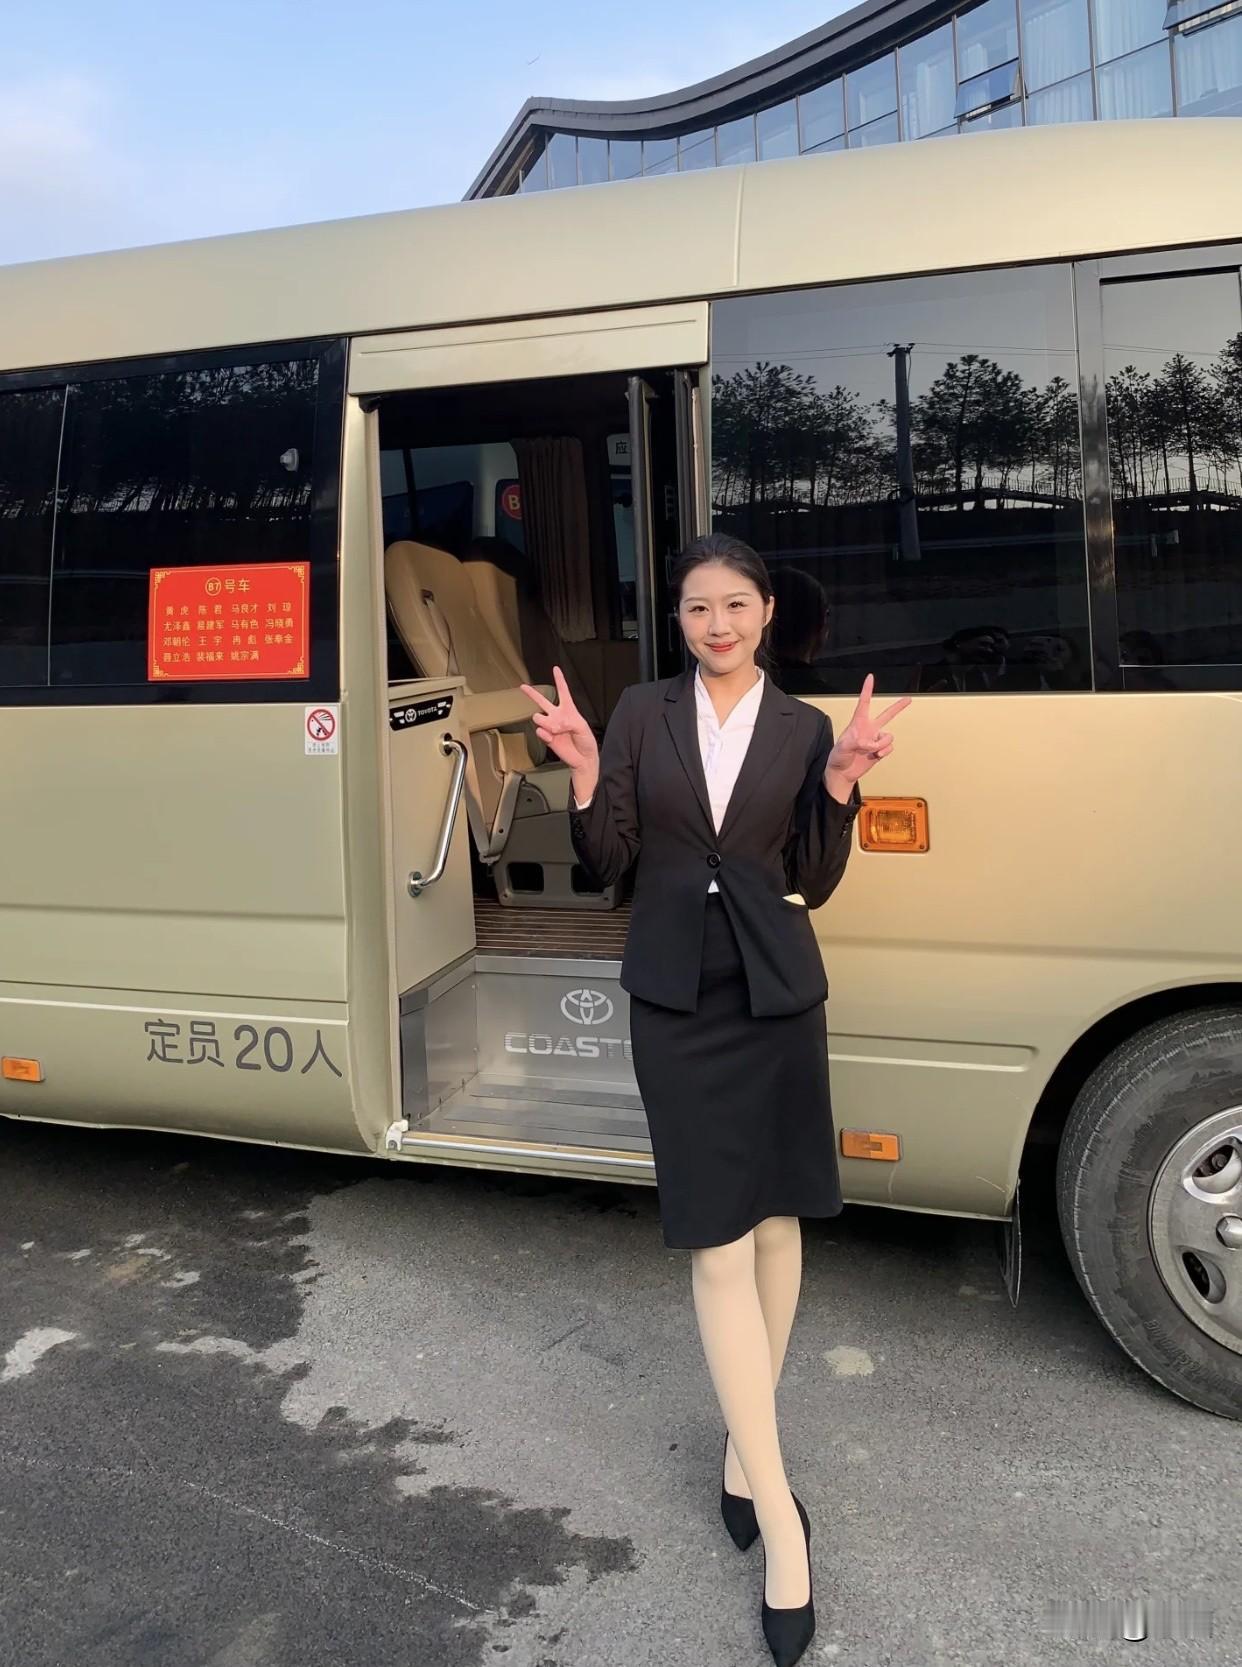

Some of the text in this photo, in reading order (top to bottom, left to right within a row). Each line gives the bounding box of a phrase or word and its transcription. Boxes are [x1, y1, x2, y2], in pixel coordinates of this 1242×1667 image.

[417, 706, 438, 717] TOYOTA
[144, 1018, 343, 1078] 定员20人
